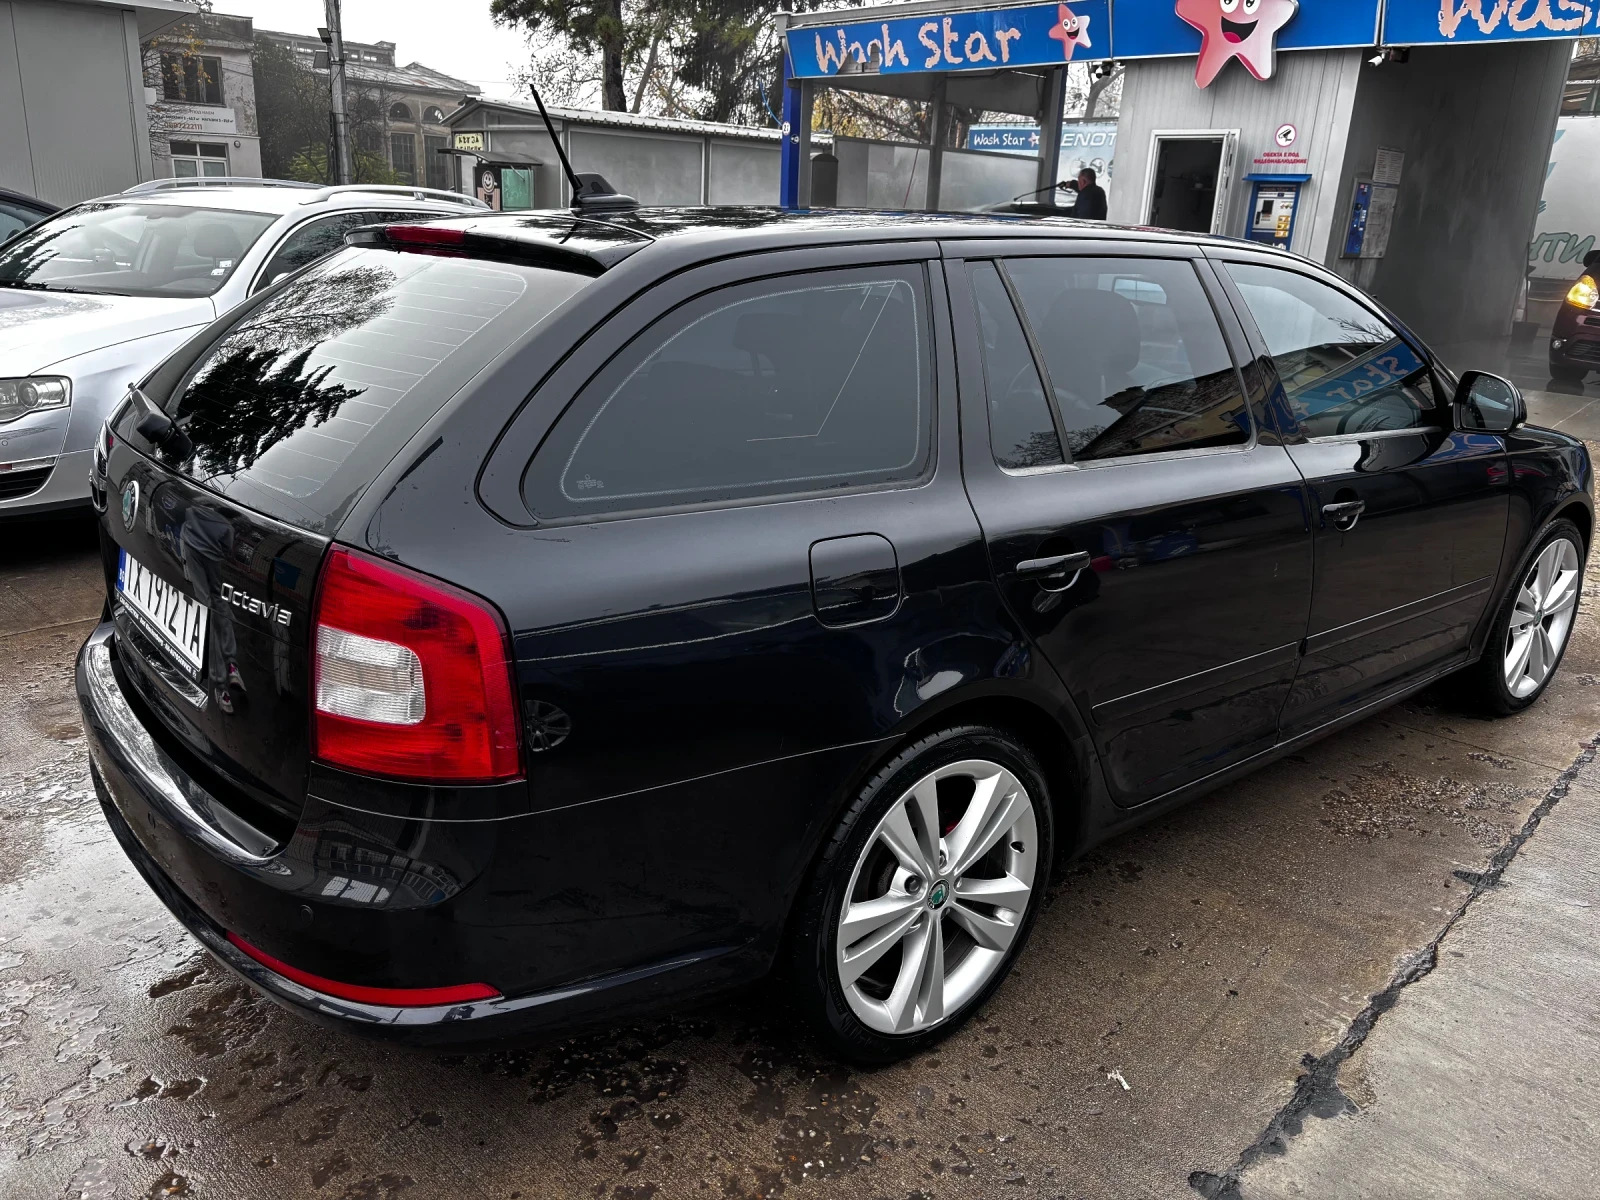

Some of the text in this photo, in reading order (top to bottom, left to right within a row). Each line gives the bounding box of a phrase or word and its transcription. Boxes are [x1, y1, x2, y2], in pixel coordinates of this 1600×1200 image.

[918, 17, 1021, 69] Star
[974, 133, 1026, 146] Wash Star
[221, 582, 292, 627] Octavia
